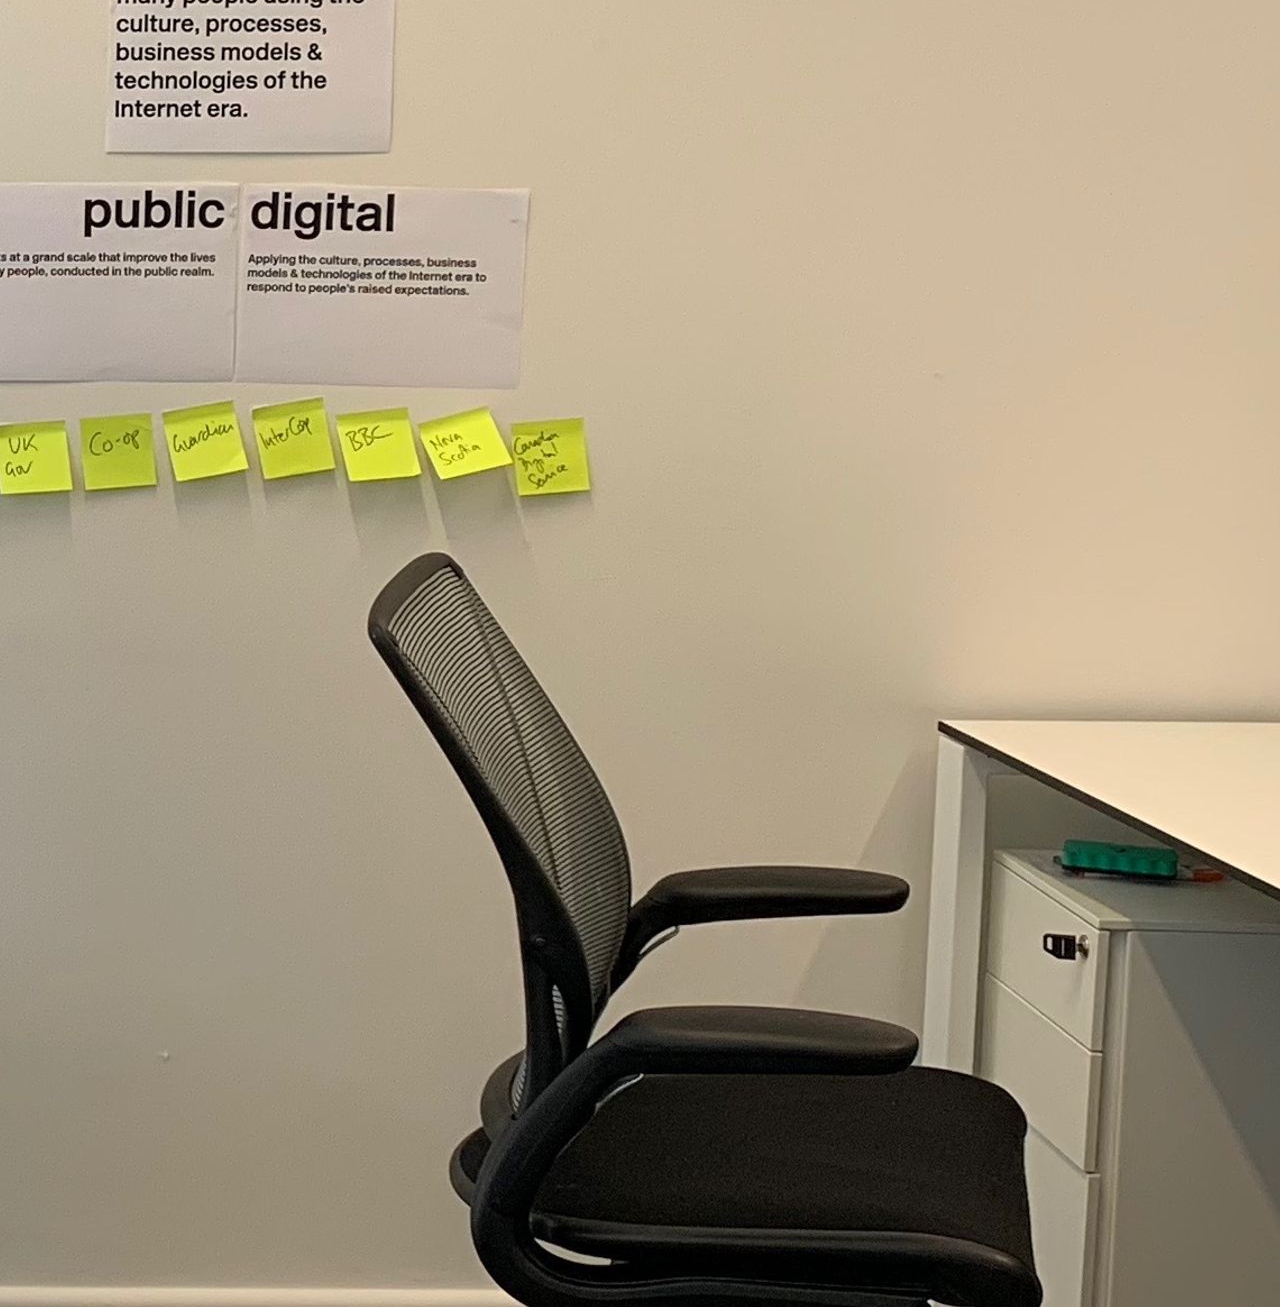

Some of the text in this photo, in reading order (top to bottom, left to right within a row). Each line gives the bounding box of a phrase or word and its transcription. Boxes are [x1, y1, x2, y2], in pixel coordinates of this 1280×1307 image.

[116, 14, 327, 37] culture, processes,
[116, 42, 322, 61] business models &
[115, 71, 327, 93] technologies of the
[115, 100, 248, 118] Internet era.
[84, 190, 225, 238] public
[251, 191, 395, 240] digital
[9, 252, 21, 263] at
[23, 254, 30, 263] a
[32, 252, 65, 265] grand
[67, 252, 97, 263] scale
[98, 252, 121, 263] that
[123, 252, 168, 265] improve
[170, 252, 189, 263] the
[190, 252, 216, 263] lives
[248, 254, 477, 268] Applying the culture, processes, business
[7, 265, 49, 279] people,
[50, 266, 110, 277] conducted
[111, 266, 122, 277] in
[123, 266, 143, 277] the
[144, 266, 179, 279] public
[180, 266, 215, 277] realm.
[247, 268, 487, 282] models & technologies of the Internet era to
[247, 282, 469, 297] respond to people's raised expectations.
[8, 434, 39, 455] UK
[89, 429, 140, 456] Co-op
[172, 421, 234, 454] Guardian
[345, 425, 393, 452] BBC
[429, 433, 463, 451] Nova
[438, 444, 482, 466] Scotia
[5, 460, 34, 476] Gov
